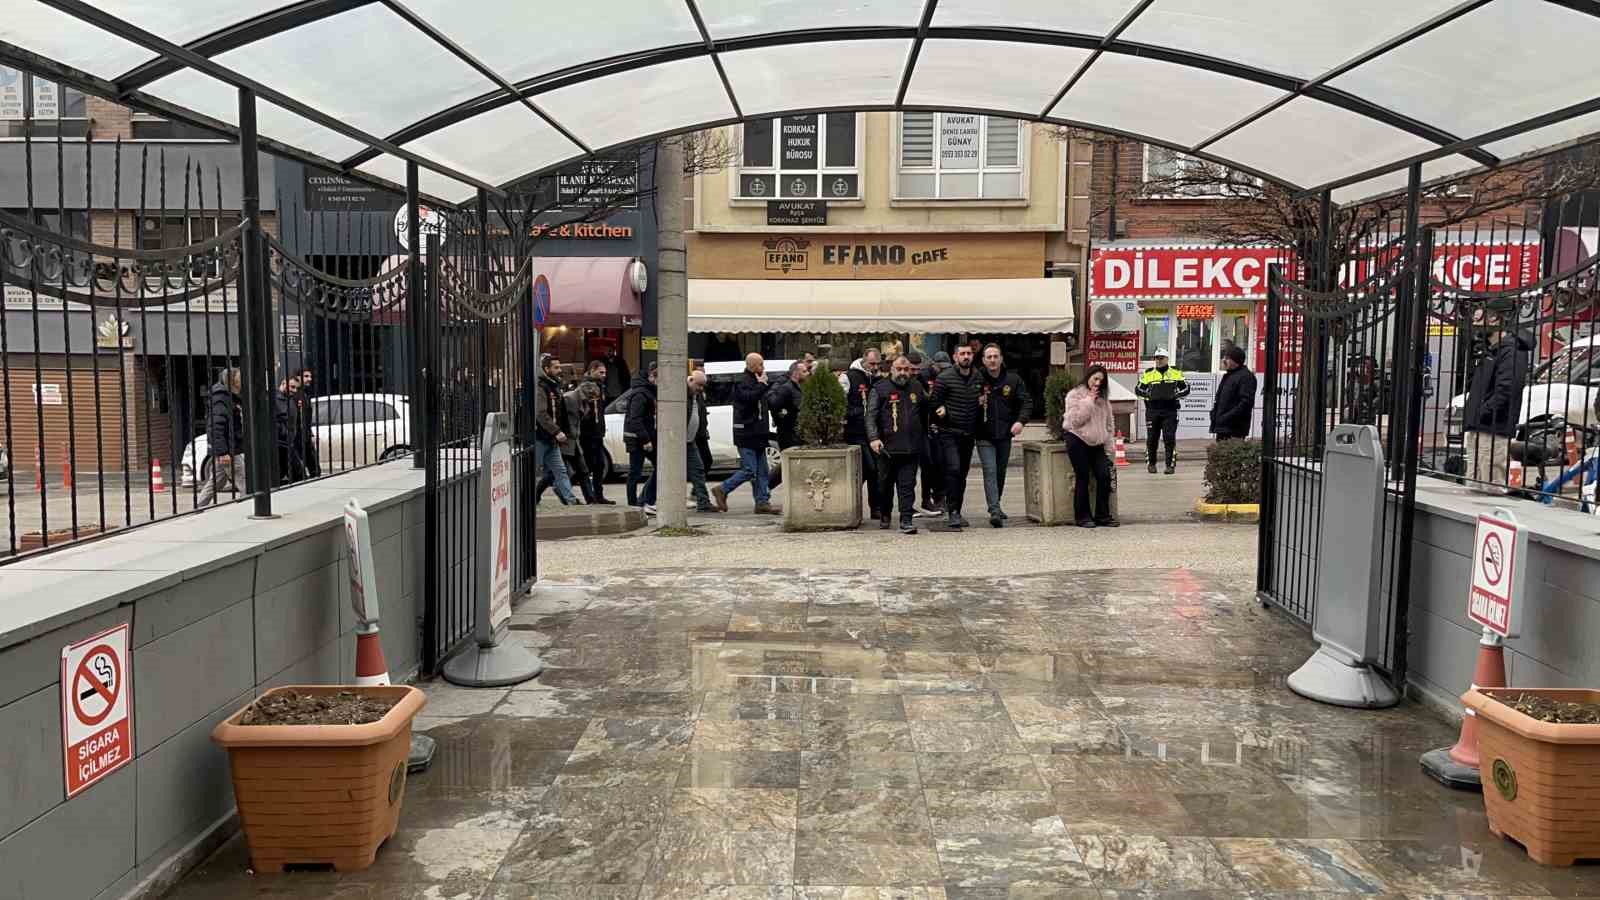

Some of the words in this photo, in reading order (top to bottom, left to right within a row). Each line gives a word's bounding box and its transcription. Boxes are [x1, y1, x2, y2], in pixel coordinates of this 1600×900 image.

[783, 125, 816, 134] KORKMAZ
[787, 138, 811, 146] HUKUK
[947, 137, 972, 146] GÜNAY
[786, 149, 813, 160] BÜROSU
[779, 202, 815, 210] AVUKAT
[575, 224, 632, 237] kitchen
[769, 254, 804, 263] EFANO
[823, 245, 906, 265] EFANO
[911, 248, 948, 265] CAFE
[1089, 339, 1136, 349] ARZUHALCİ
[79, 728, 120, 760] SİGARA
[79, 746, 121, 781] İÇİLMEZ
